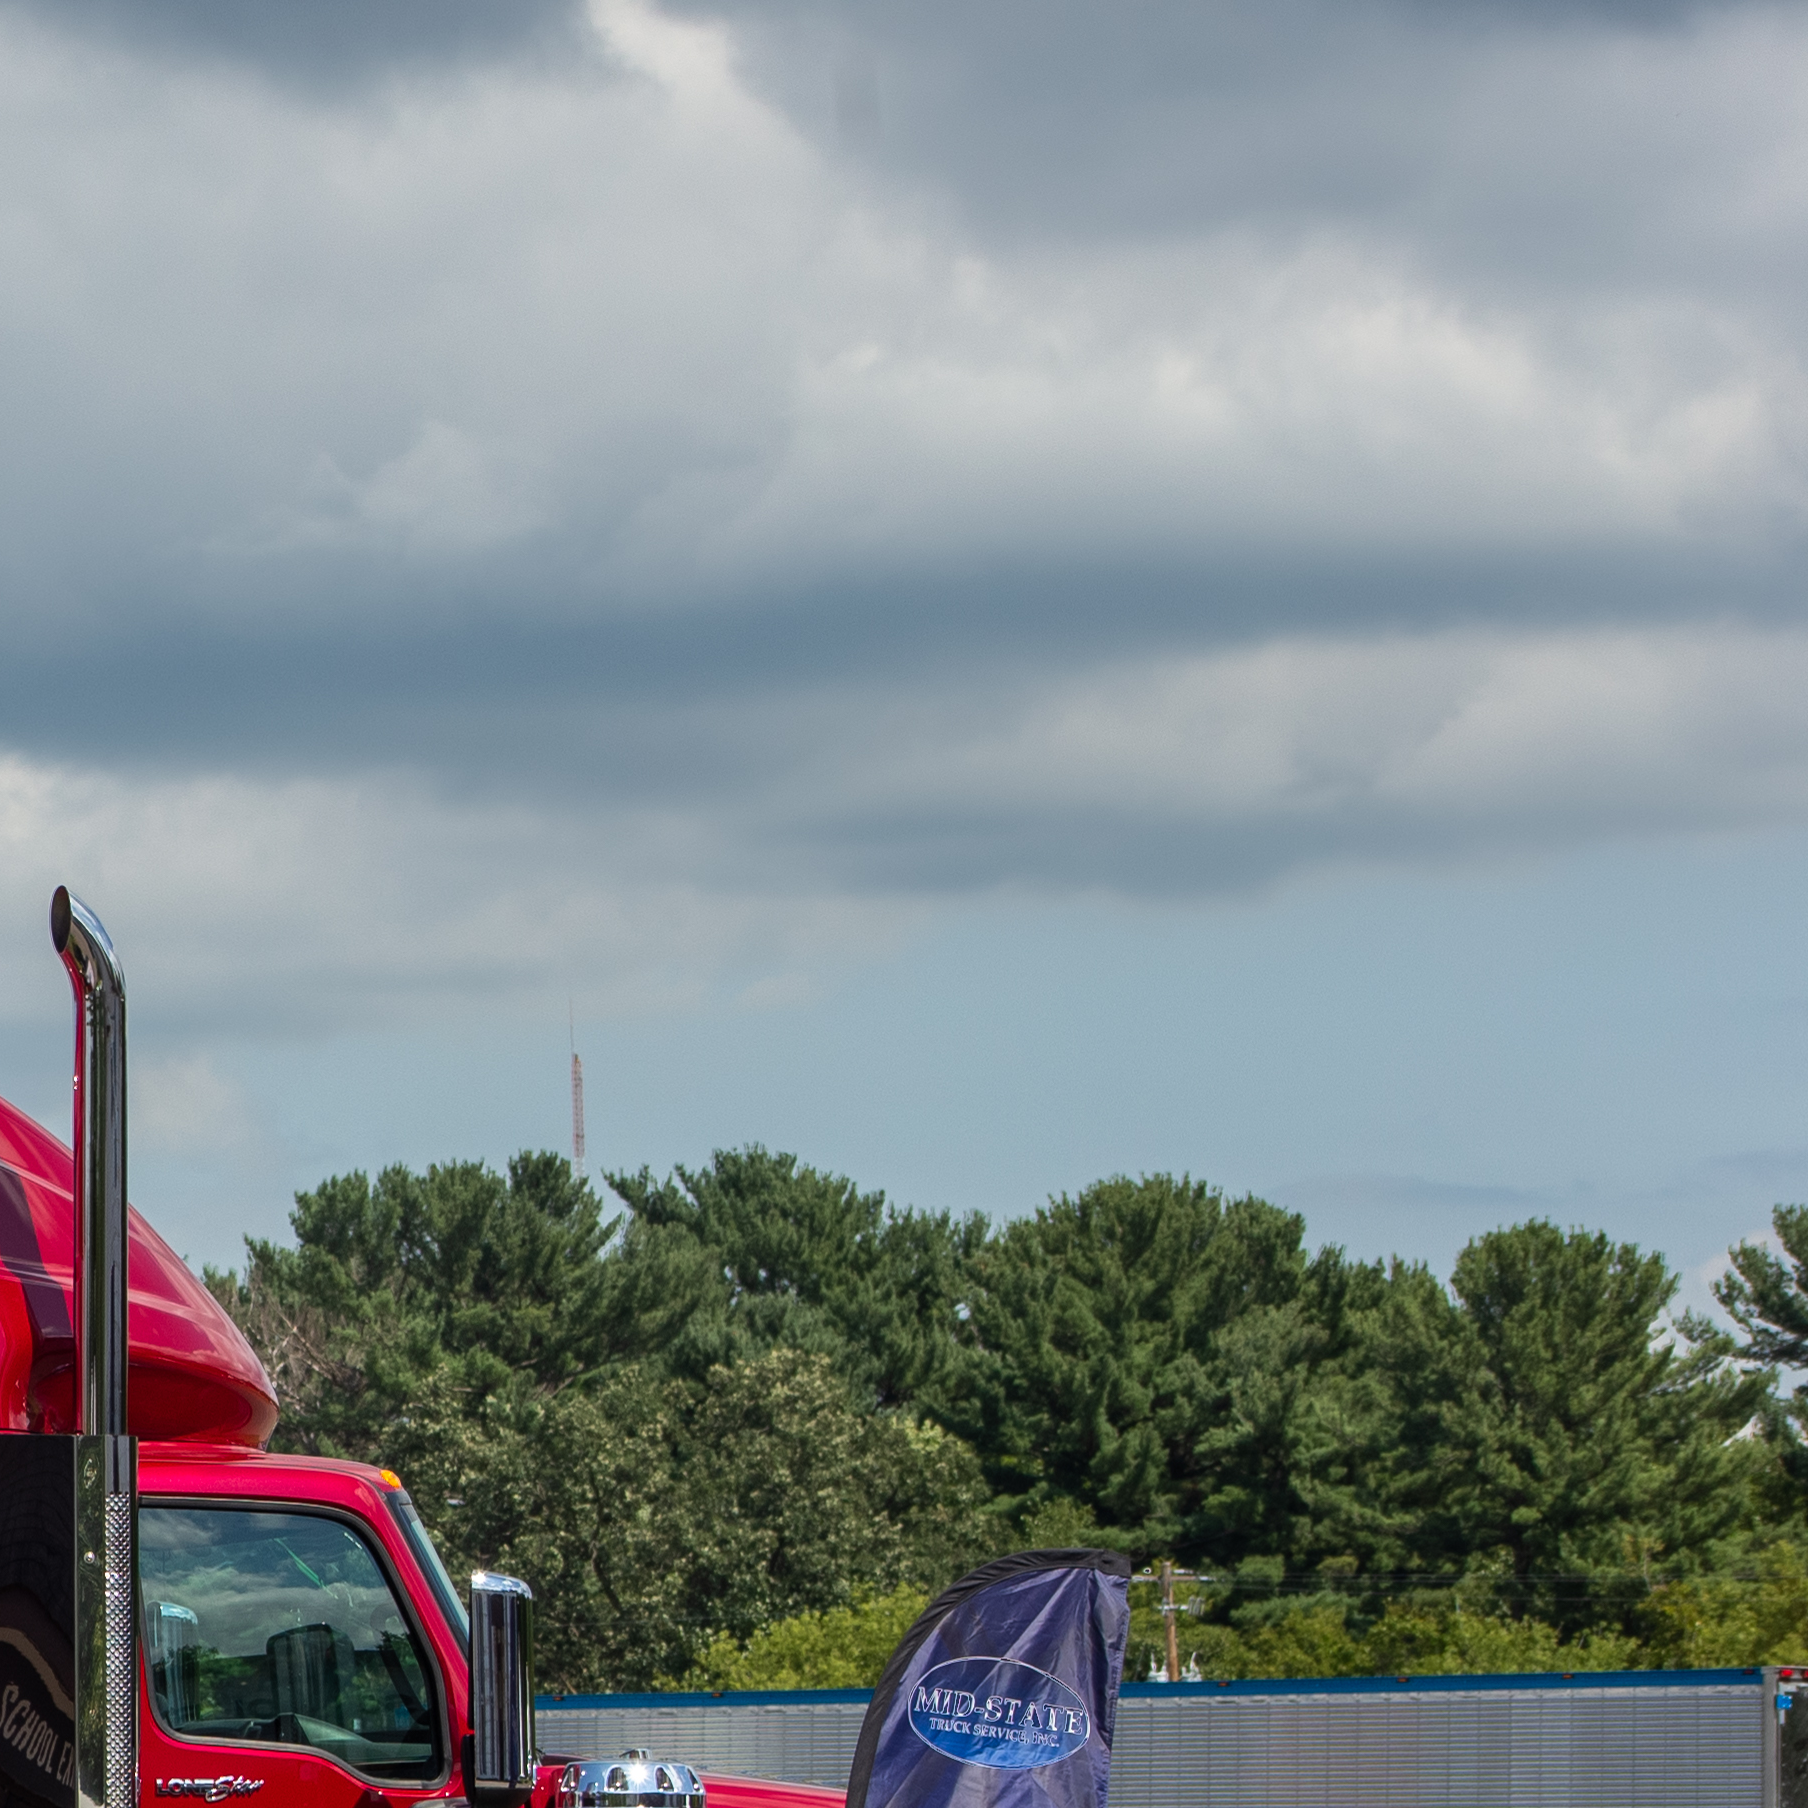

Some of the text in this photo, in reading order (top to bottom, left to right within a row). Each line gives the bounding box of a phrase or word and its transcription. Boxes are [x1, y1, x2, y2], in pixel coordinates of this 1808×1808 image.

[913, 1686, 1084, 1735] MID-STATE
[929, 1717, 1060, 1747] TRUCK SERVICE, INC.
